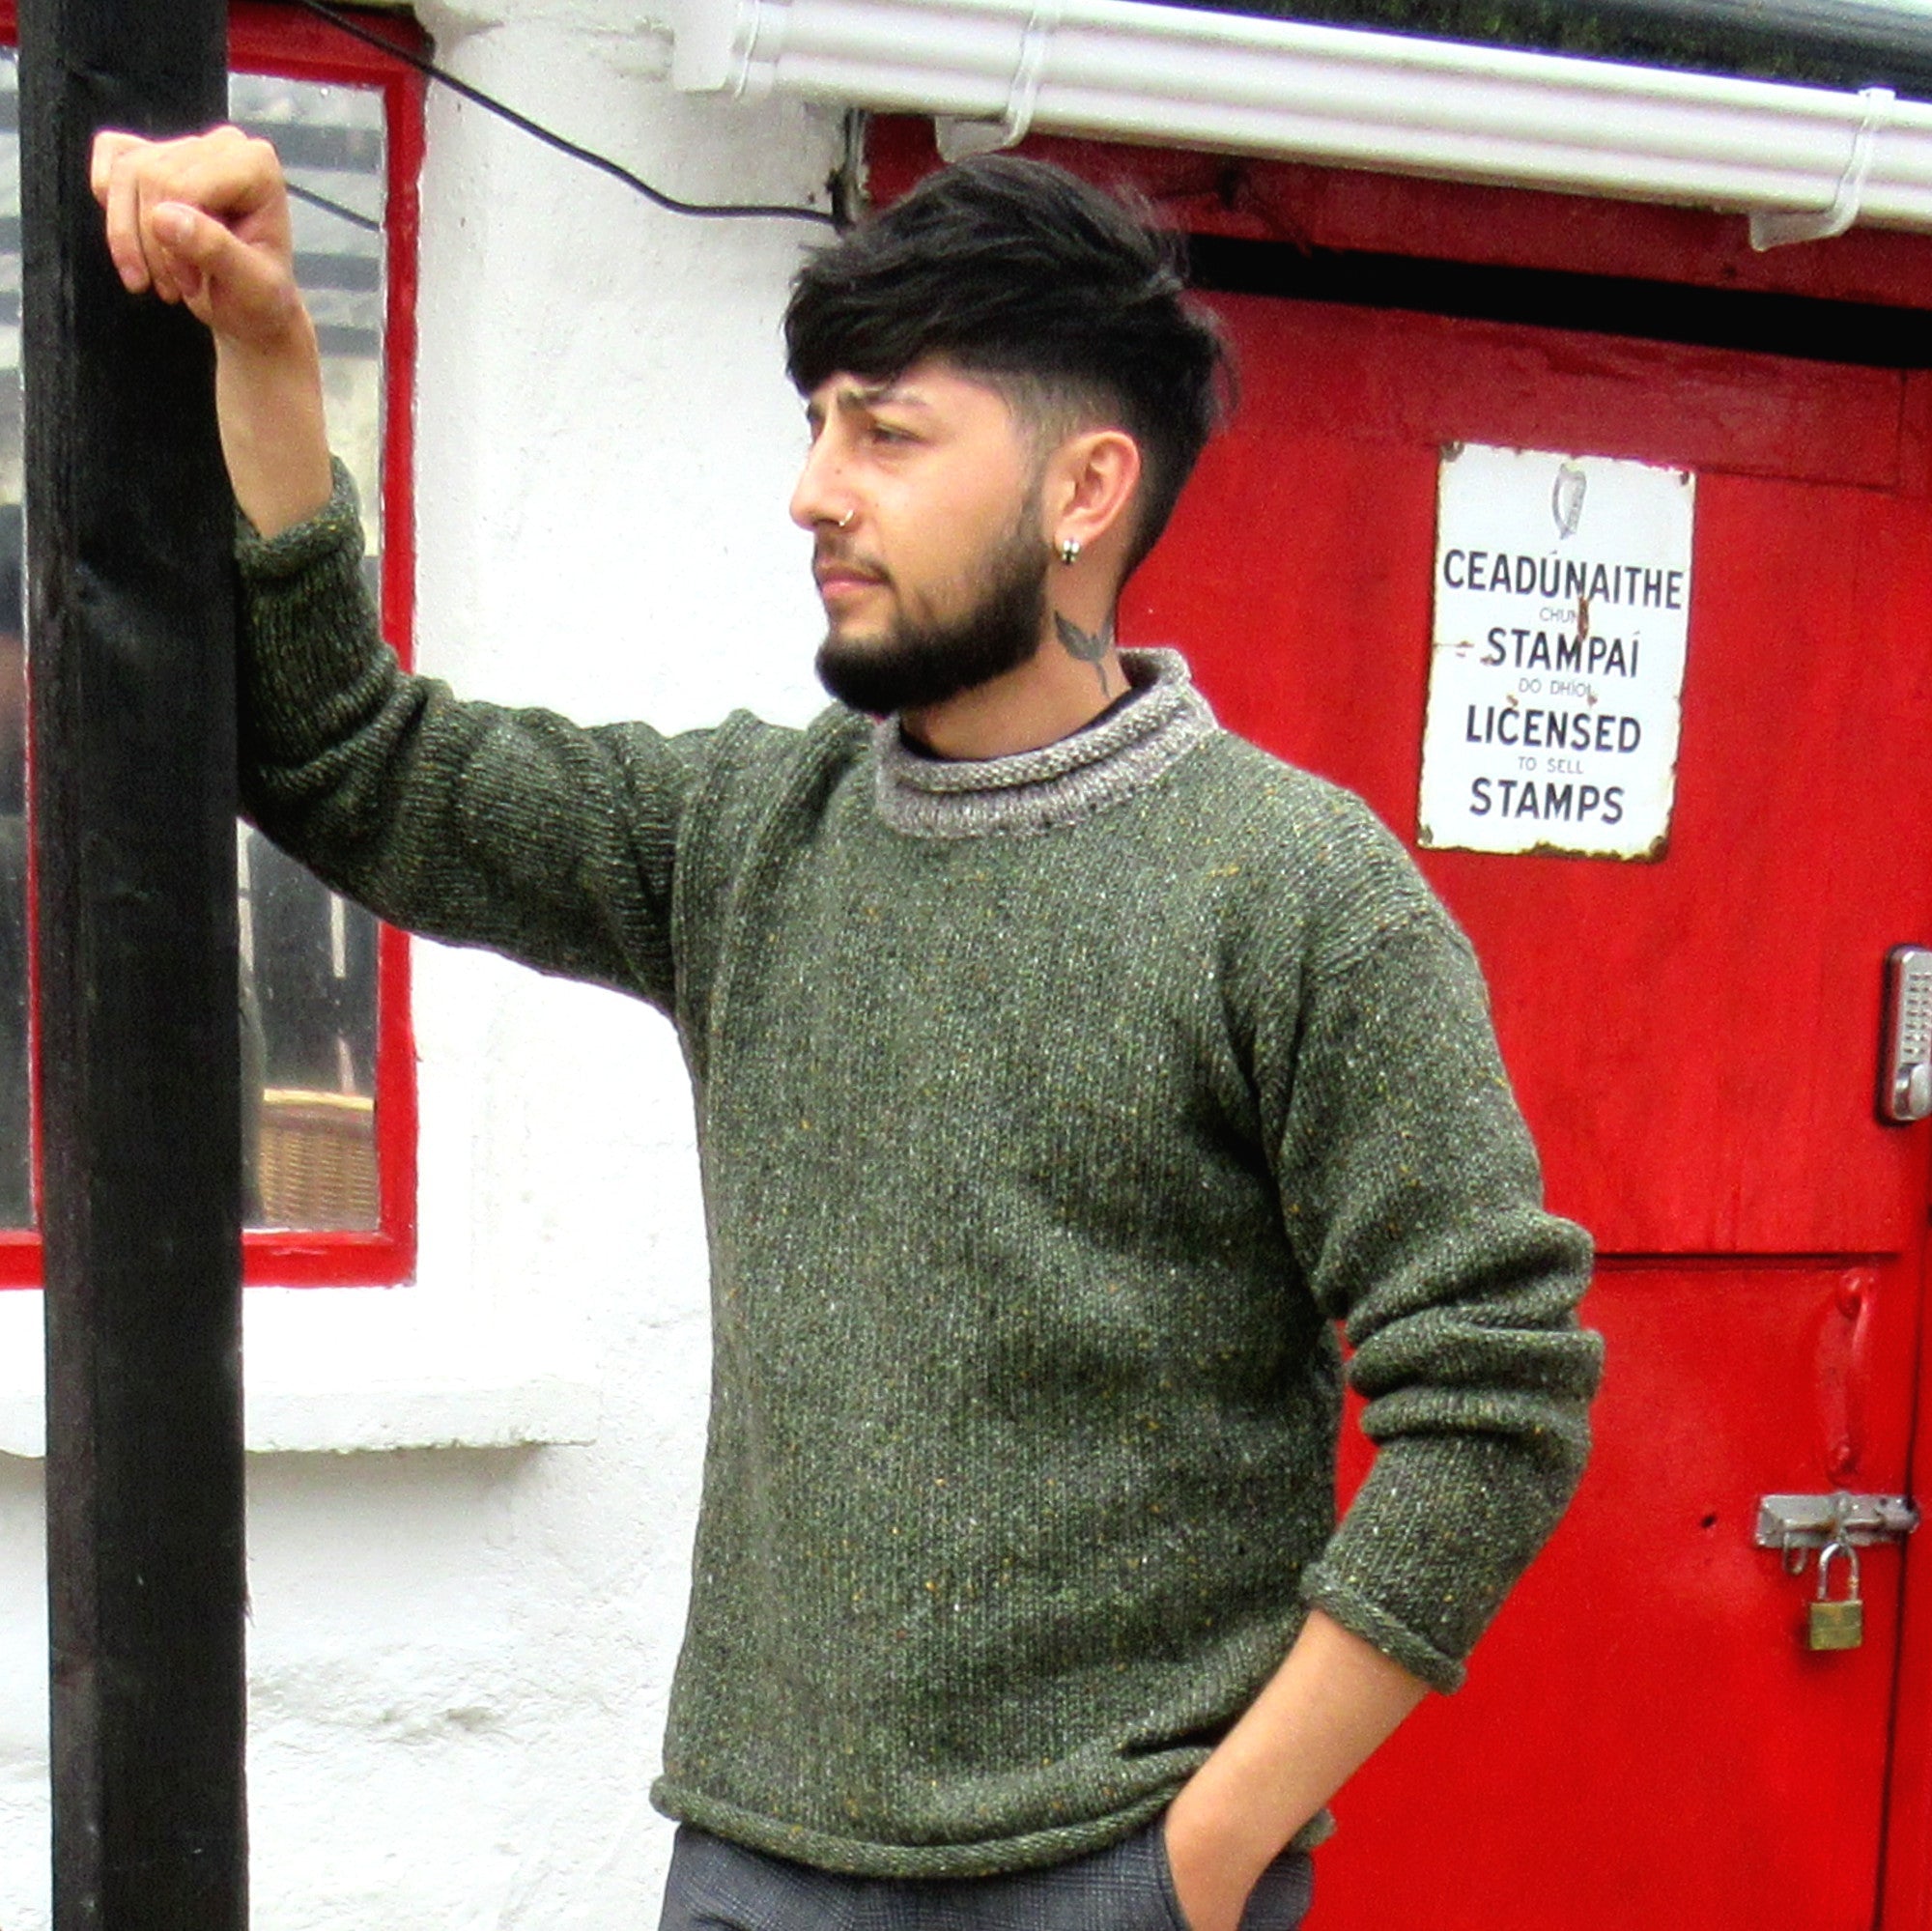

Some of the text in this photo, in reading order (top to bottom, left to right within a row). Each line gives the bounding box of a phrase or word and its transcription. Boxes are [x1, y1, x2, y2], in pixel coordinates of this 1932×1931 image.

[1443, 549, 1684, 610] CEADÚNAITHE
[1488, 627, 1640, 678] STAMPAÍ
[1519, 677, 1542, 694] DO
[1465, 704, 1641, 753] LICENSED
[1519, 755, 1583, 774] TO SELL
[1469, 777, 1624, 825] STAMPS
